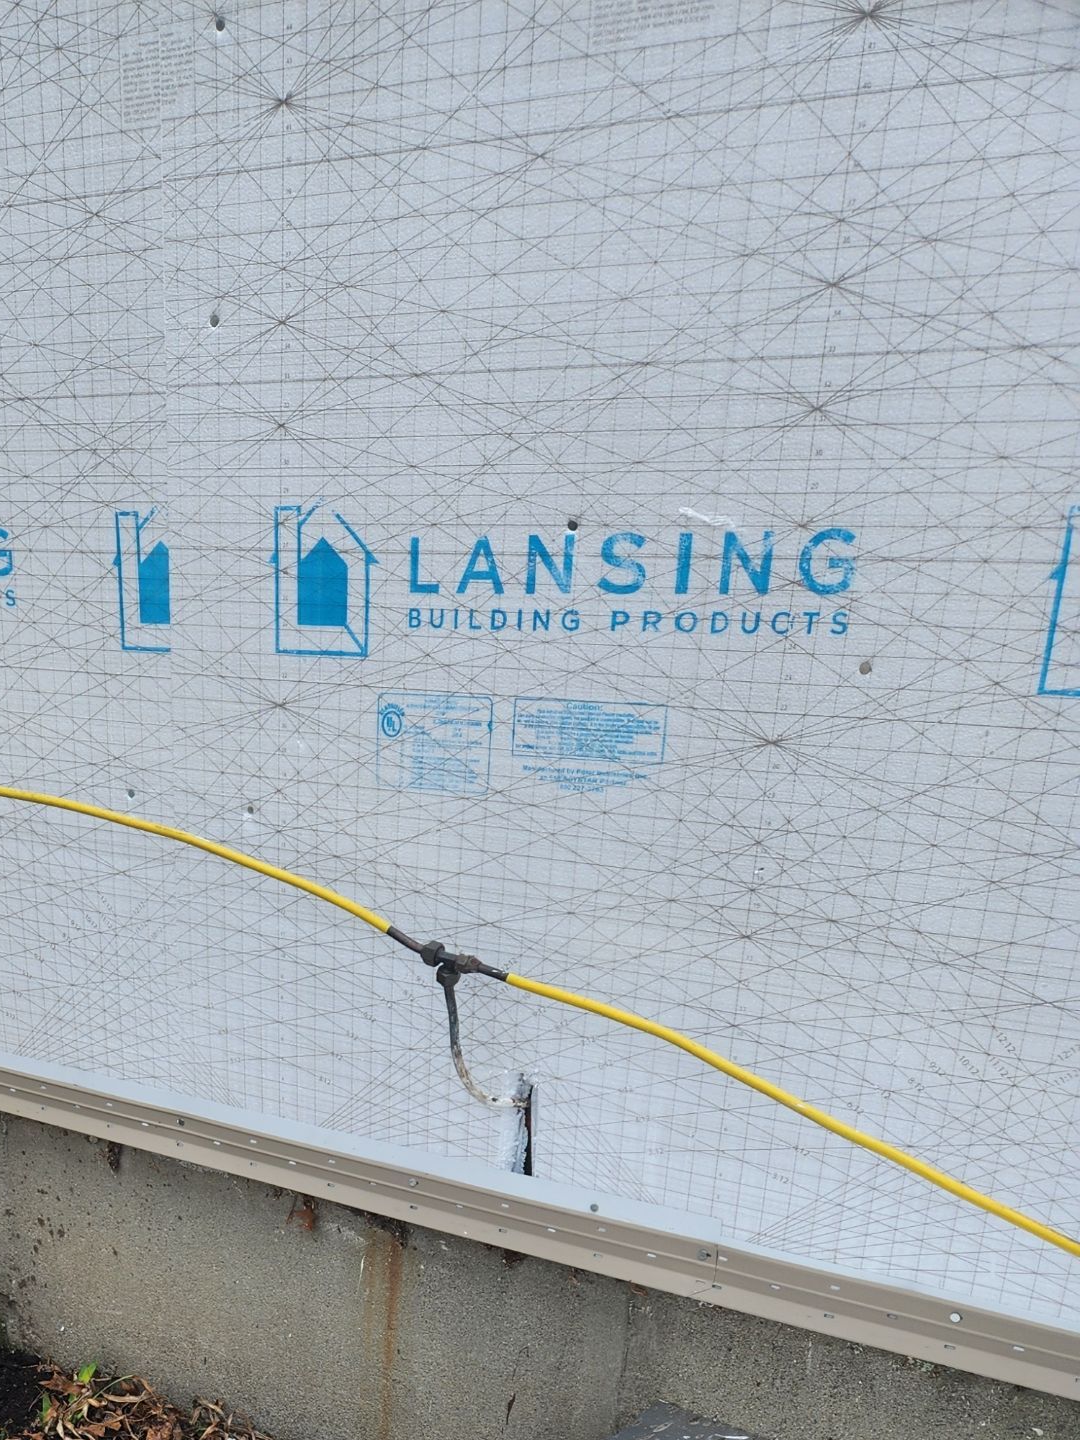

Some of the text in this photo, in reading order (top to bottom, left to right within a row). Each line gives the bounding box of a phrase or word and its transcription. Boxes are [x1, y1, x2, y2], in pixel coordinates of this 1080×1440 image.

[409, 527, 857, 596] LANSING
[408, 607, 849, 635] BUILDING PRODUCTS
